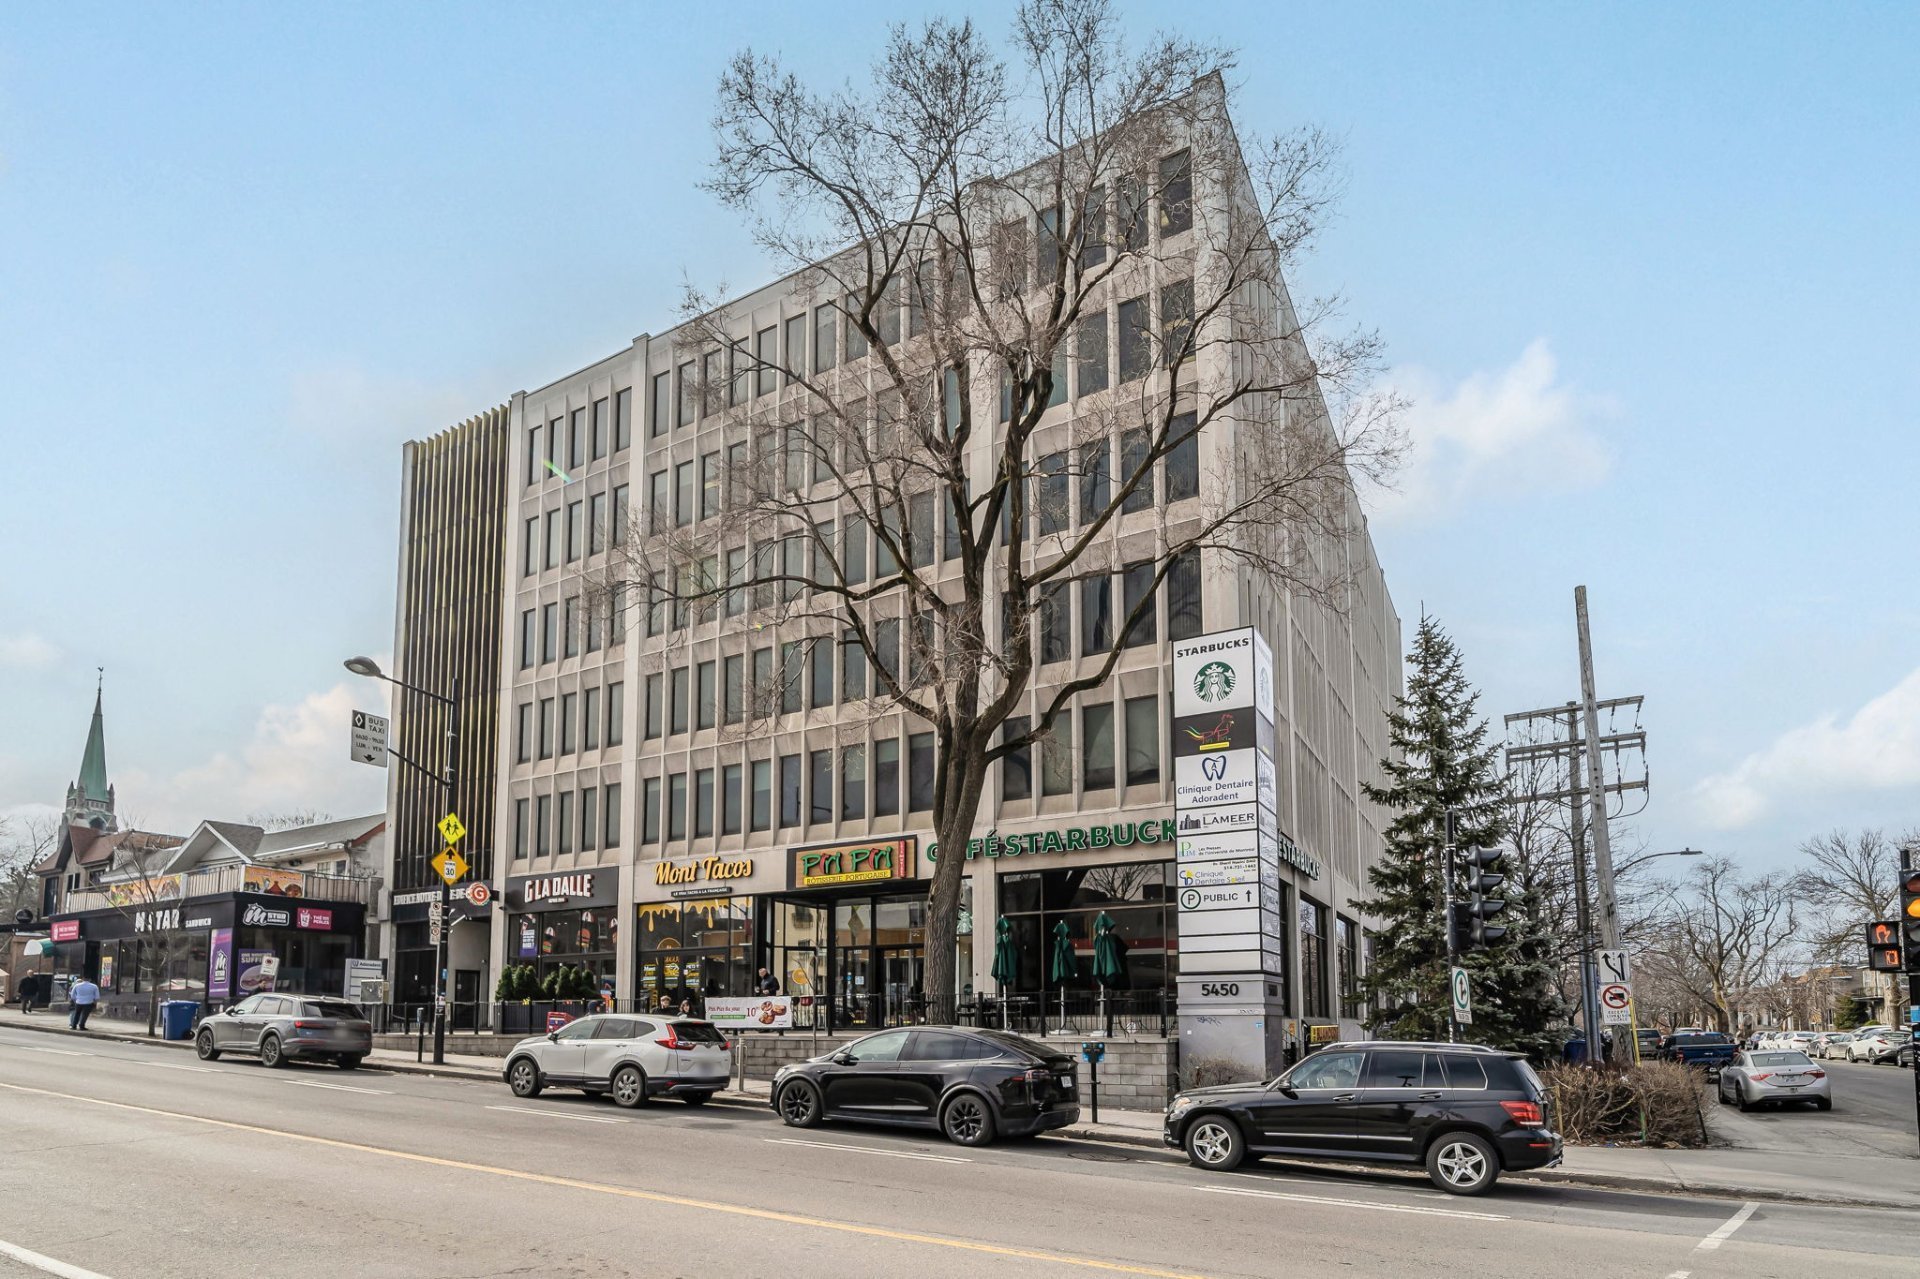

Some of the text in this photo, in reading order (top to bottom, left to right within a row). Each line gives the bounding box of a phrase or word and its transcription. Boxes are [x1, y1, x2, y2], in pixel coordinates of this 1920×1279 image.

[1177, 638, 1249, 658] STARBUCKS
[368, 717, 384, 726] BUS
[369, 725, 385, 734] TAXI
[1178, 779, 1253, 795] Clinique Dentaire
[1192, 792, 1239, 804] Adoradent
[1203, 813, 1255, 825] LAMEER
[926, 829, 1000, 863] CFÉ
[1004, 818, 1176, 857] STARBUCK
[445, 867, 455, 876] 30
[656, 856, 753, 885] Mont Tacos
[552, 874, 593, 897] DALLE
[474, 887, 484, 899] G
[1187, 892, 1239, 905] P PUBLIC
[185, 917, 212, 928] SANDWICH
[1201, 983, 1239, 997] 5450
